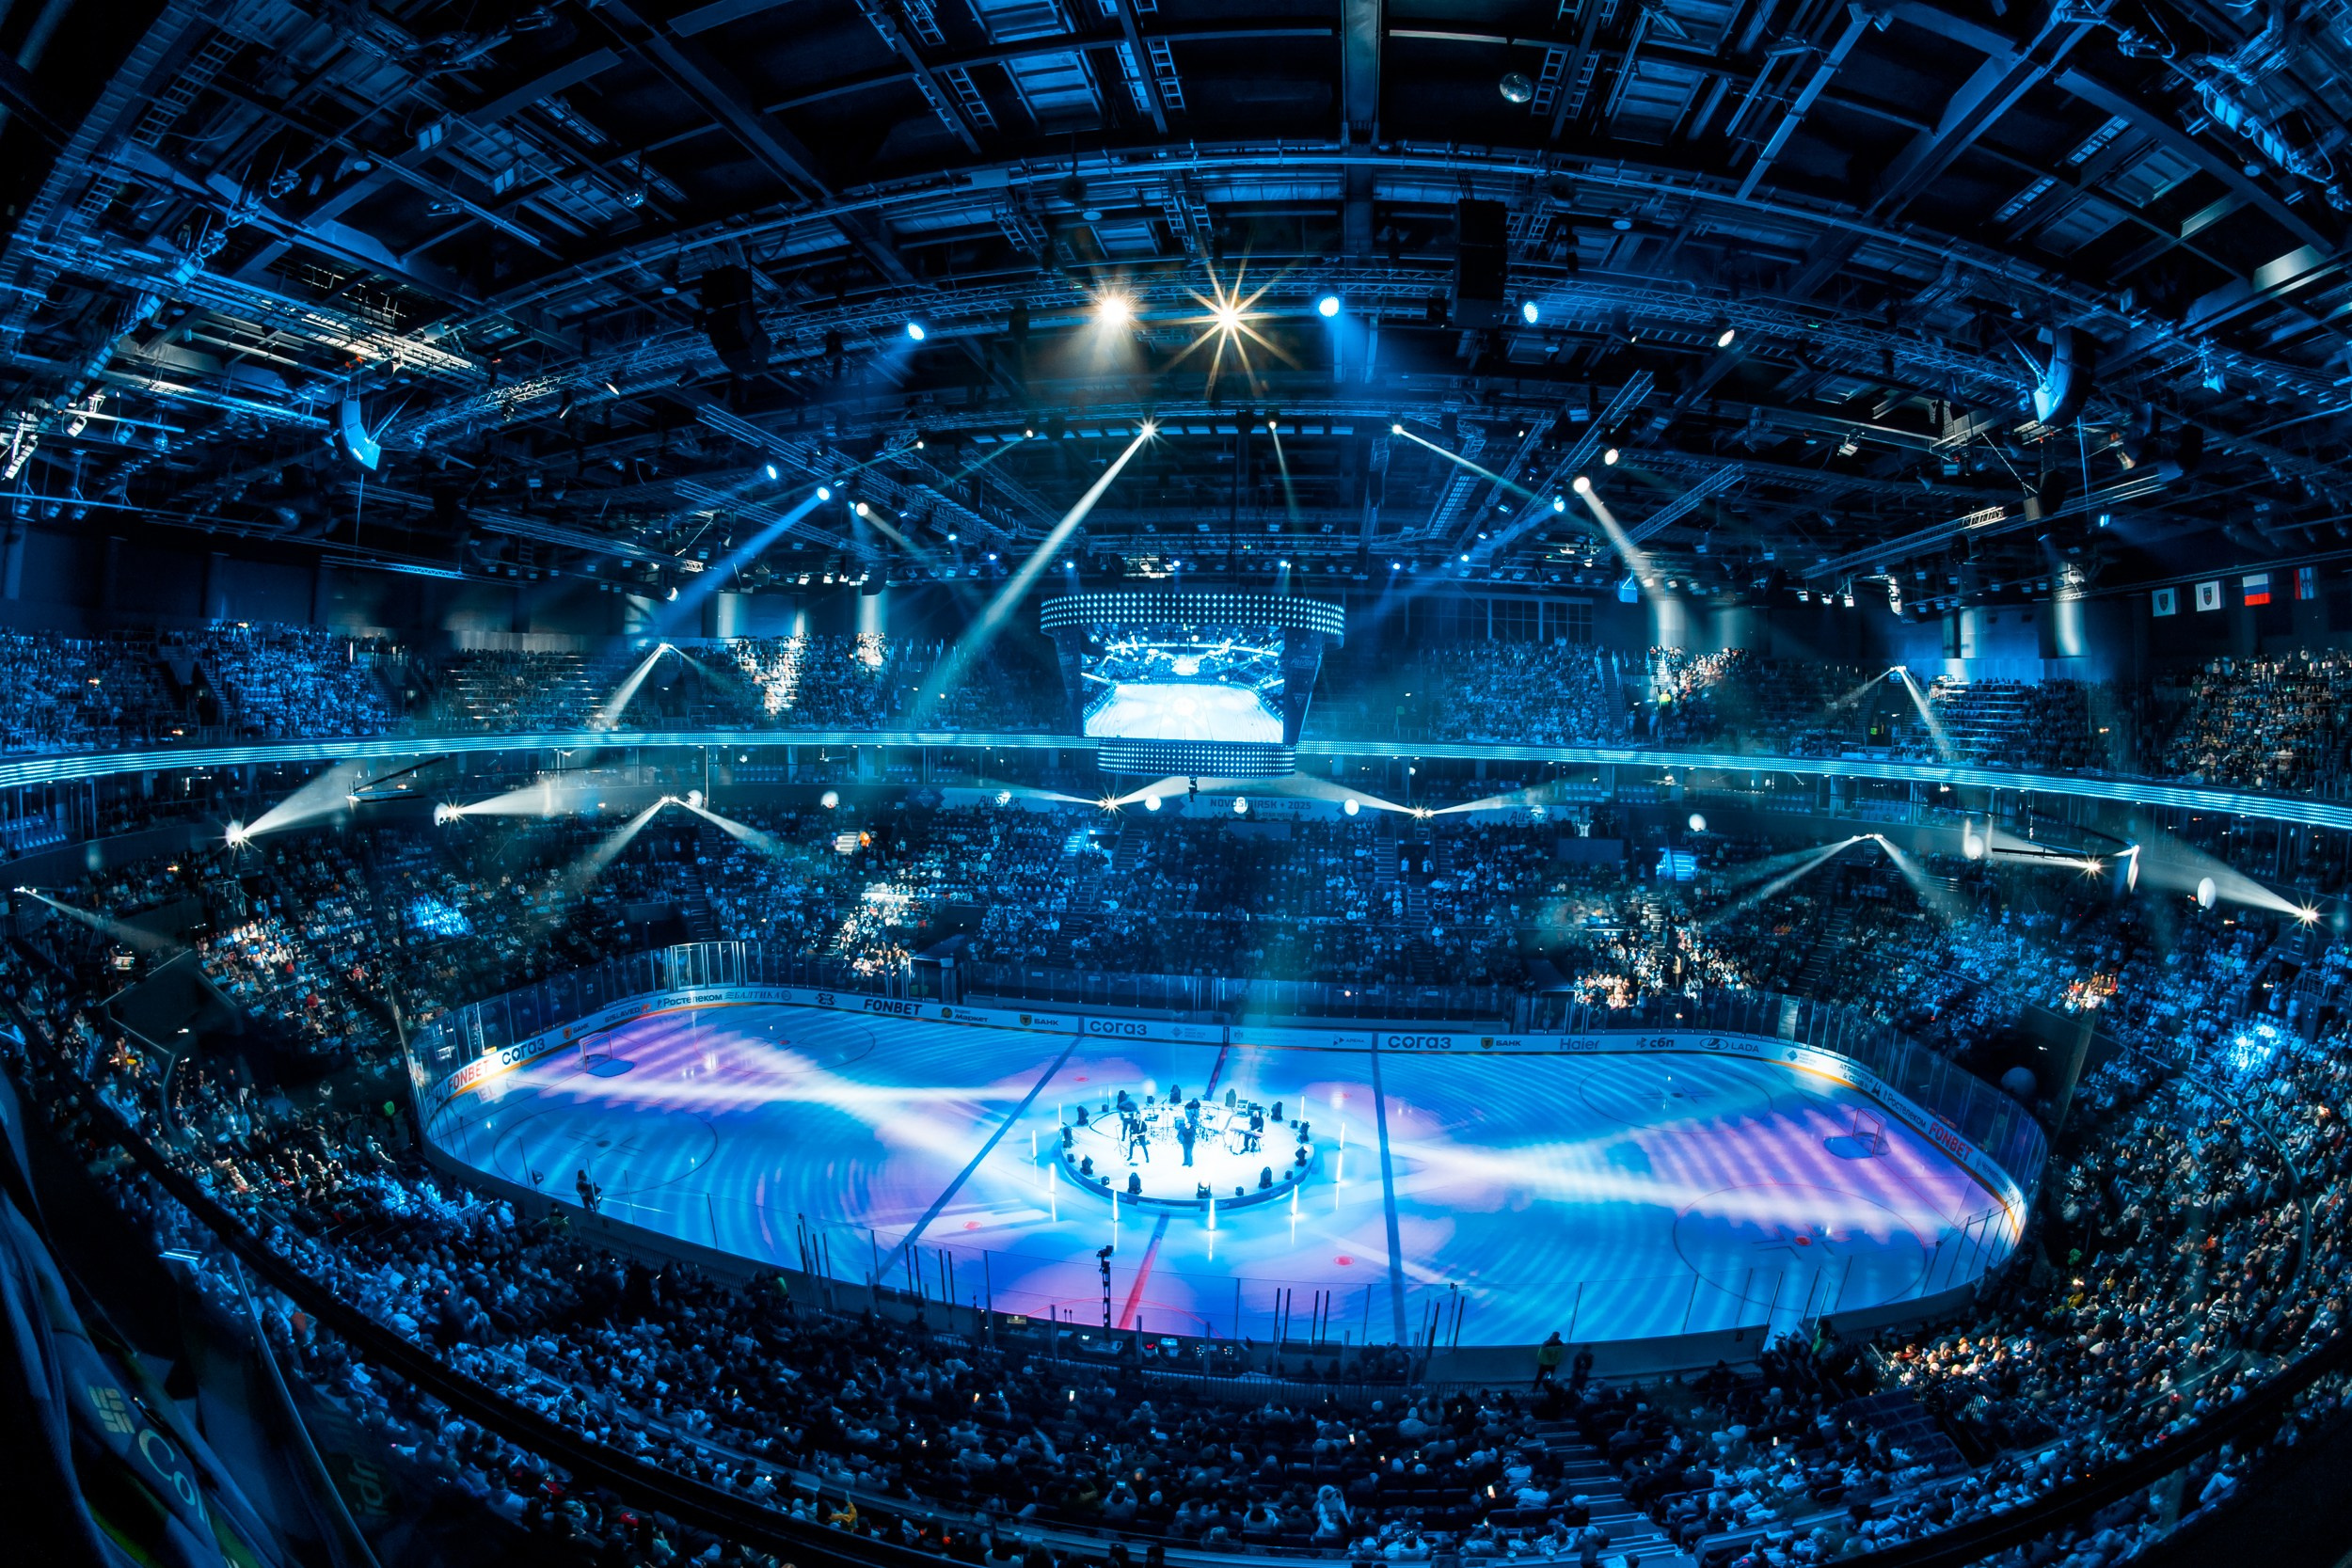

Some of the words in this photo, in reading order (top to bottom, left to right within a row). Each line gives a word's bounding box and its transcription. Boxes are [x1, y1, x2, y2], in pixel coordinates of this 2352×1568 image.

[1287, 800, 1311, 810] 2025
[733, 990, 780, 1000] БАЛТИКА
[864, 999, 922, 1016] FONBET
[1034, 1018, 1059, 1027] БАНК
[1559, 1037, 1600, 1051] Haier
[1731, 1041, 1759, 1053] LADA
[448, 1060, 489, 1094] FONBET
[1887, 1091, 1927, 1129] Ростелеком
[1928, 1121, 1974, 1162] FONBET
